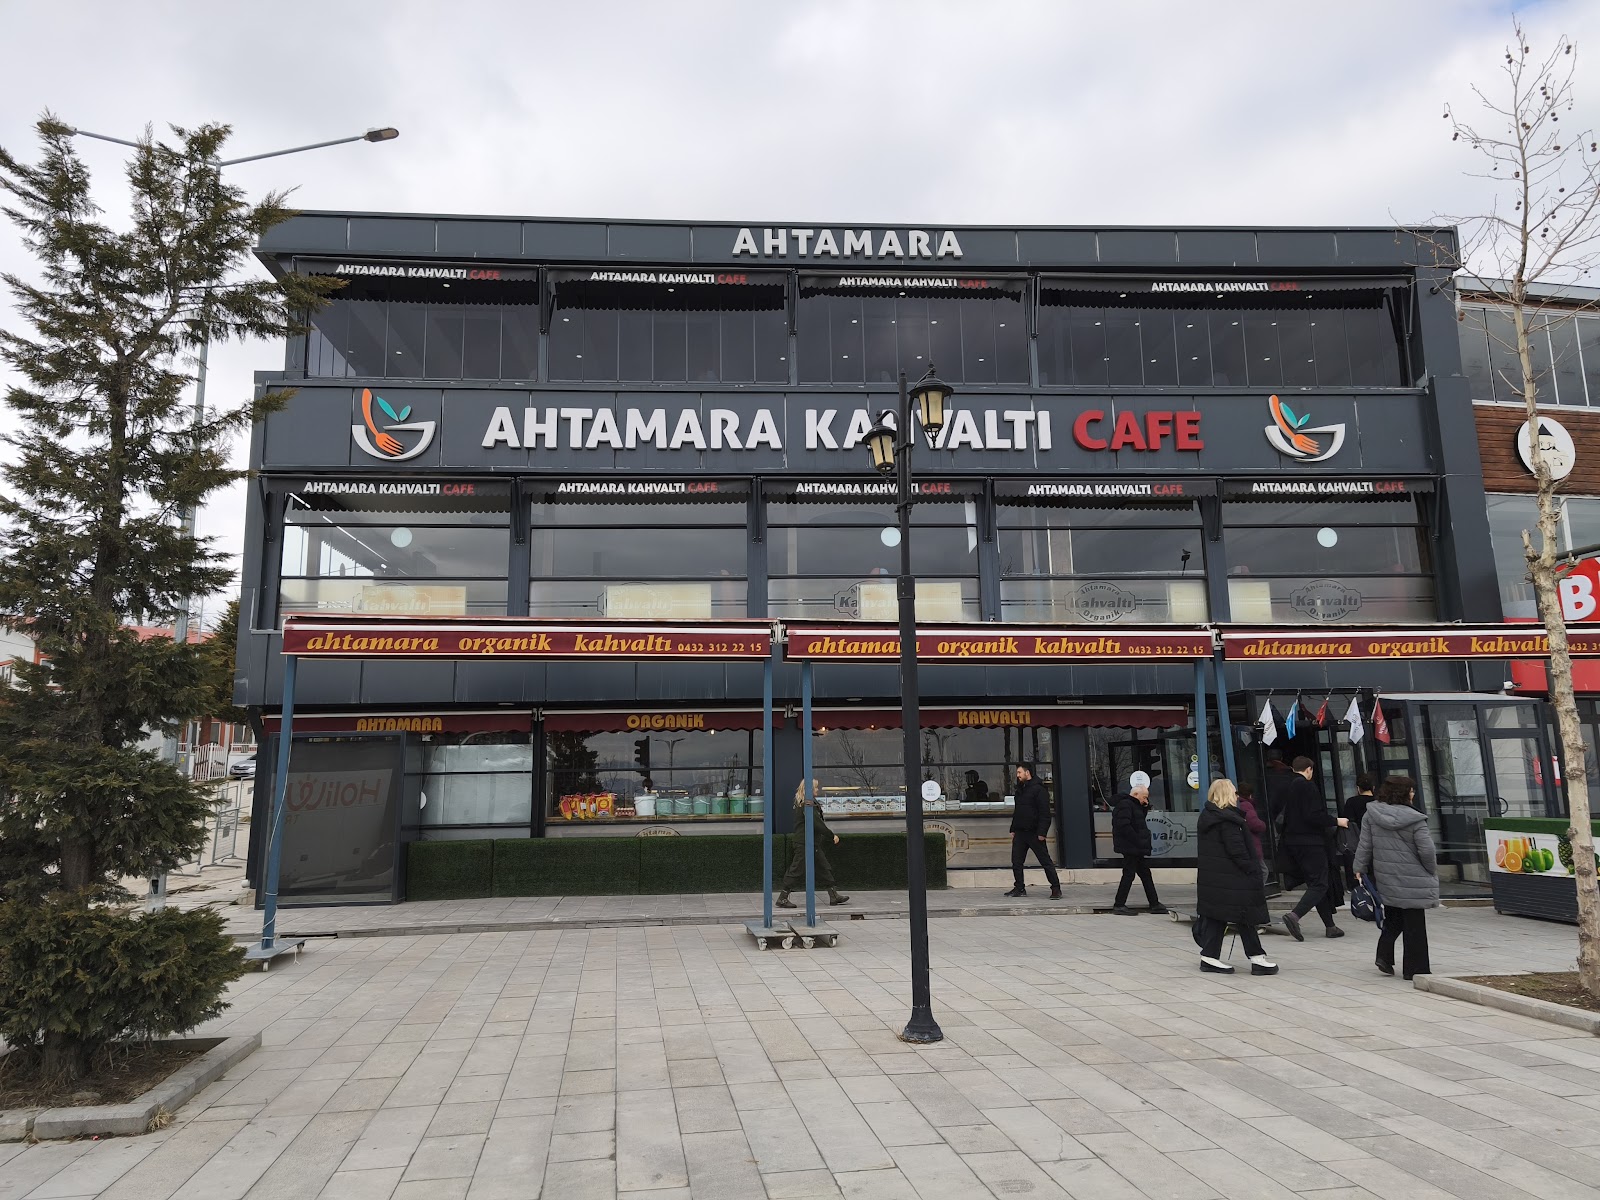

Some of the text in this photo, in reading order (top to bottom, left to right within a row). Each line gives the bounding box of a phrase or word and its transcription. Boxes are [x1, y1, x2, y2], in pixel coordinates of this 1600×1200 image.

[732, 228, 963, 258] AHTAMARA
[336, 264, 501, 280] AHTAMARA KAHVALTI CAFE
[590, 272, 747, 285] AHTAMARA KAHVALTI CAFE
[839, 277, 902, 287] AHTAMARA
[904, 278, 958, 287] KAHVALTI
[1152, 282, 1214, 292] AHTAMARA
[1215, 282, 1270, 292] KAHVALTI
[481, 406, 782, 449] AHTAMARA
[1072, 410, 1204, 451] CAFE
[303, 482, 475, 495] AHTAMARA KAHVALTI CAFE
[557, 482, 718, 493] AHTAMARA KAHVALTI CAFE
[796, 482, 951, 494] AHTAMARA KAHVTI CAFE
[1028, 484, 1184, 495] AHTAMARA KAHVALTI CAFE
[1252, 481, 1406, 493] AHTAMARA KAHVALTI CAFE
[1559, 574, 1600, 621] B
[306, 632, 763, 655] ahtamara organik kahvaltı 0432 312 22 15
[937, 637, 1018, 656] organik
[1034, 637, 1121, 654] kahvaltı
[1128, 646, 1151, 654] 0432
[1155, 646, 1173, 654] 312
[1176, 646, 1189, 654] 22
[1193, 646, 1205, 654] 15
[1243, 640, 1352, 656] ahtamara
[1368, 637, 1450, 657] organik
[1470, 636, 1550, 652] kahvalt
[356, 717, 442, 731] AHTAMARA
[958, 711, 1031, 724] KAHVALTI
[1152, 829, 1183, 841] valtı
